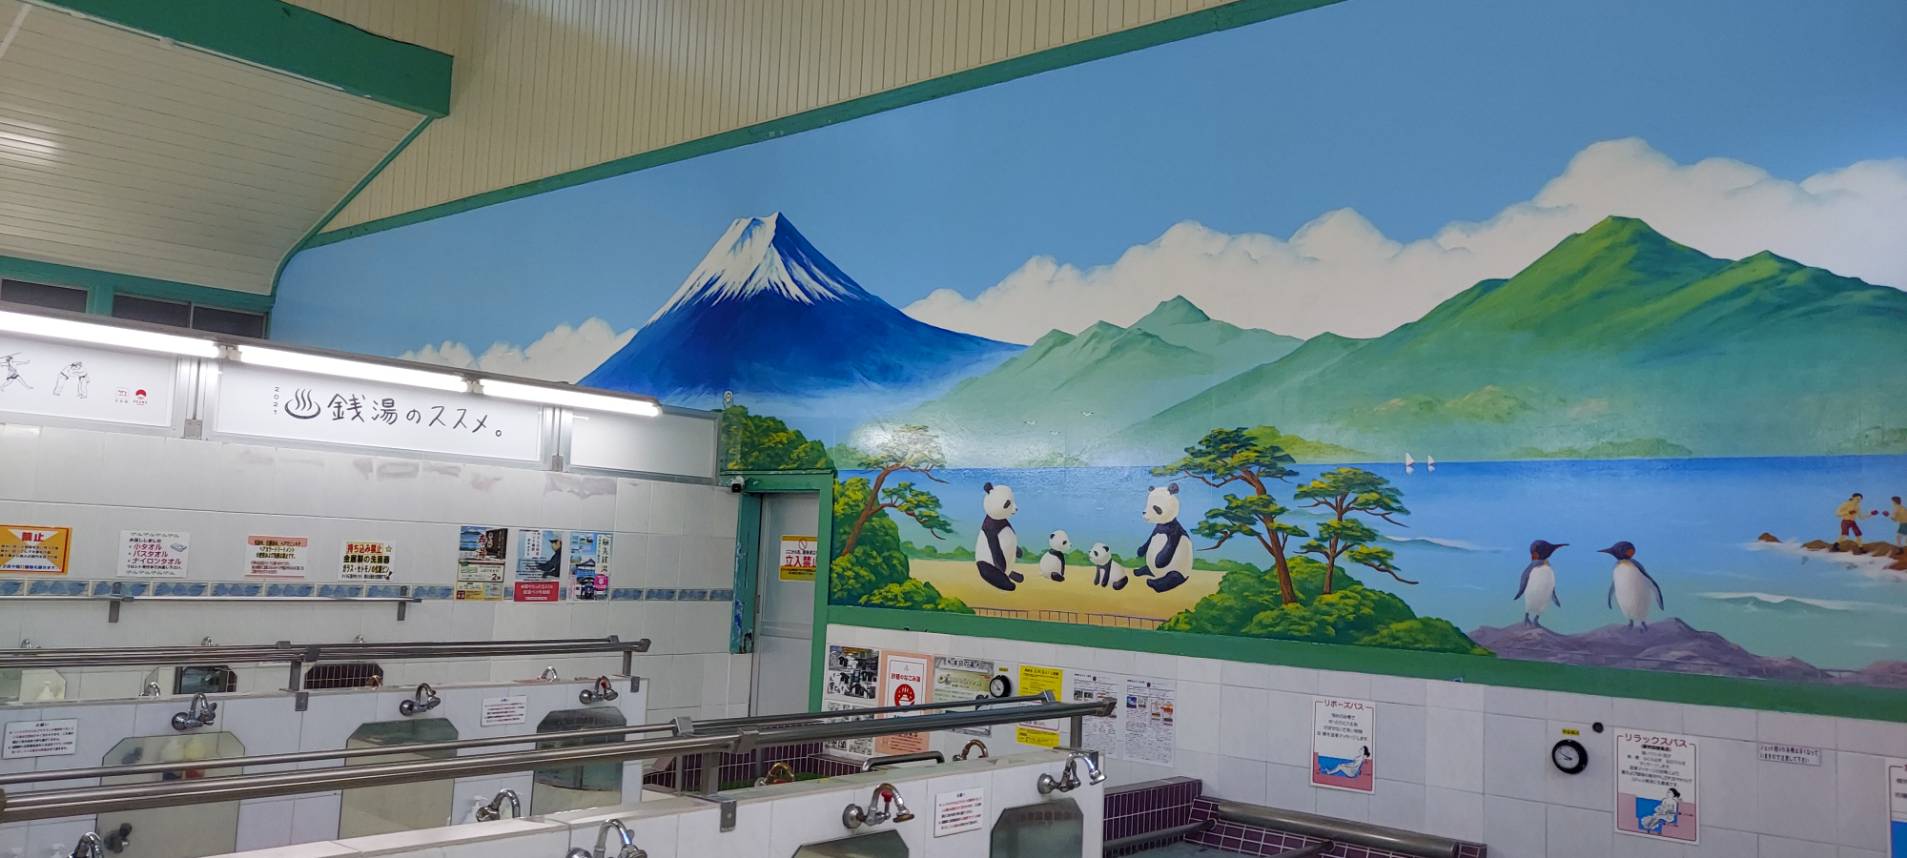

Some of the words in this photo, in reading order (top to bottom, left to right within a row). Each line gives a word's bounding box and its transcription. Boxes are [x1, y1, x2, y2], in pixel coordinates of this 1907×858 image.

[327, 393, 502, 437] 銭湯のススメ。
[133, 550, 168, 558] バスタオル
[1625, 733, 1688, 748] リラックスバス
